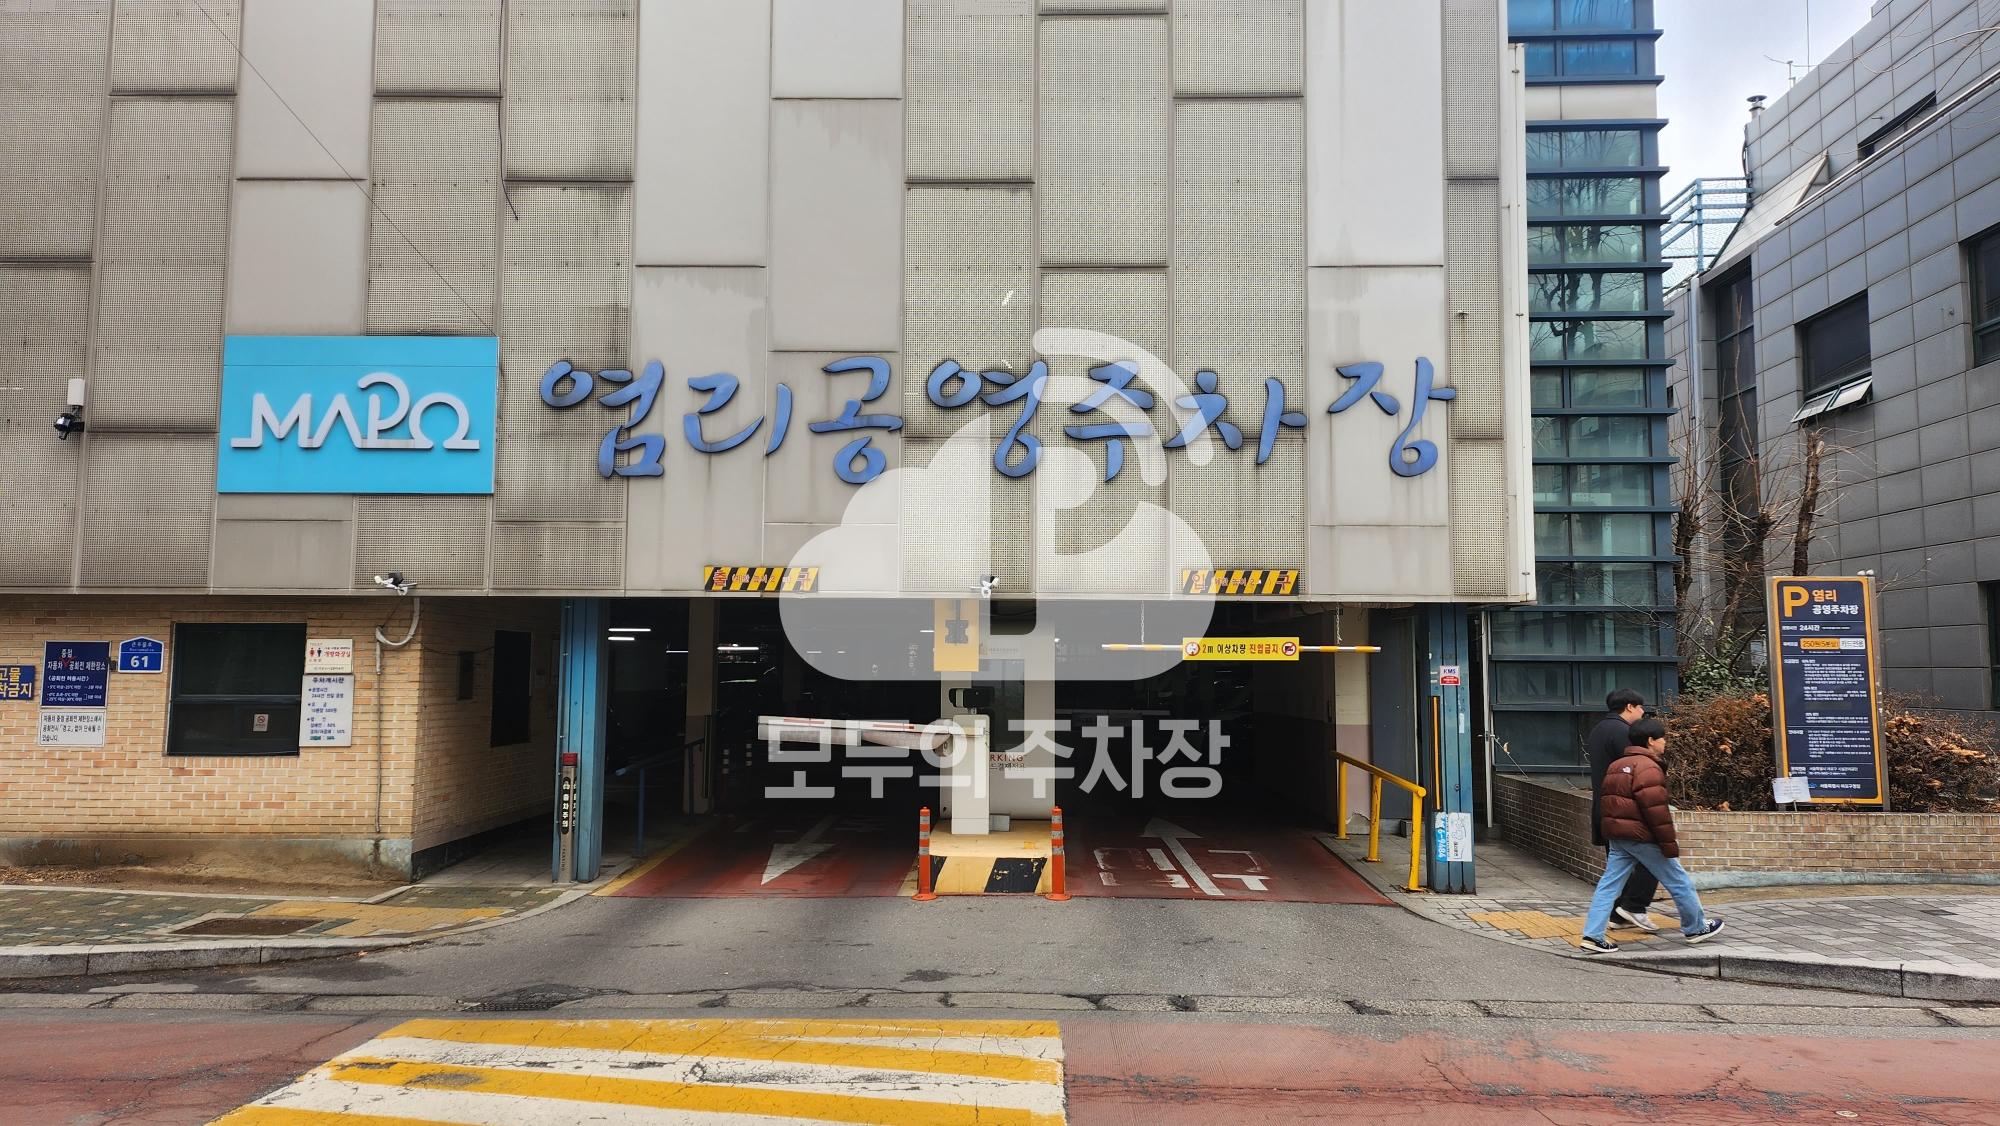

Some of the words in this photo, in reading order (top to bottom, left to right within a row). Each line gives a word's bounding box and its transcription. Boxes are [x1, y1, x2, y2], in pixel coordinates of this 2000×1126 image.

[1811, 588, 1837, 602] 염리
[1782, 585, 1810, 617] P
[1812, 604, 1859, 615] 공영주차장
[324, 650, 351, 658] 개방화장실
[1202, 644, 1214, 654] 2m
[1217, 643, 1246, 655] 이상차량
[1249, 643, 1279, 655] 진입금지
[47, 661, 63, 671] 자동차
[69, 661, 85, 671] 공회전
[85, 661, 106, 671] 제한장소
[130, 655, 149, 668] 61
[990, 754, 1024, 762] RKING
